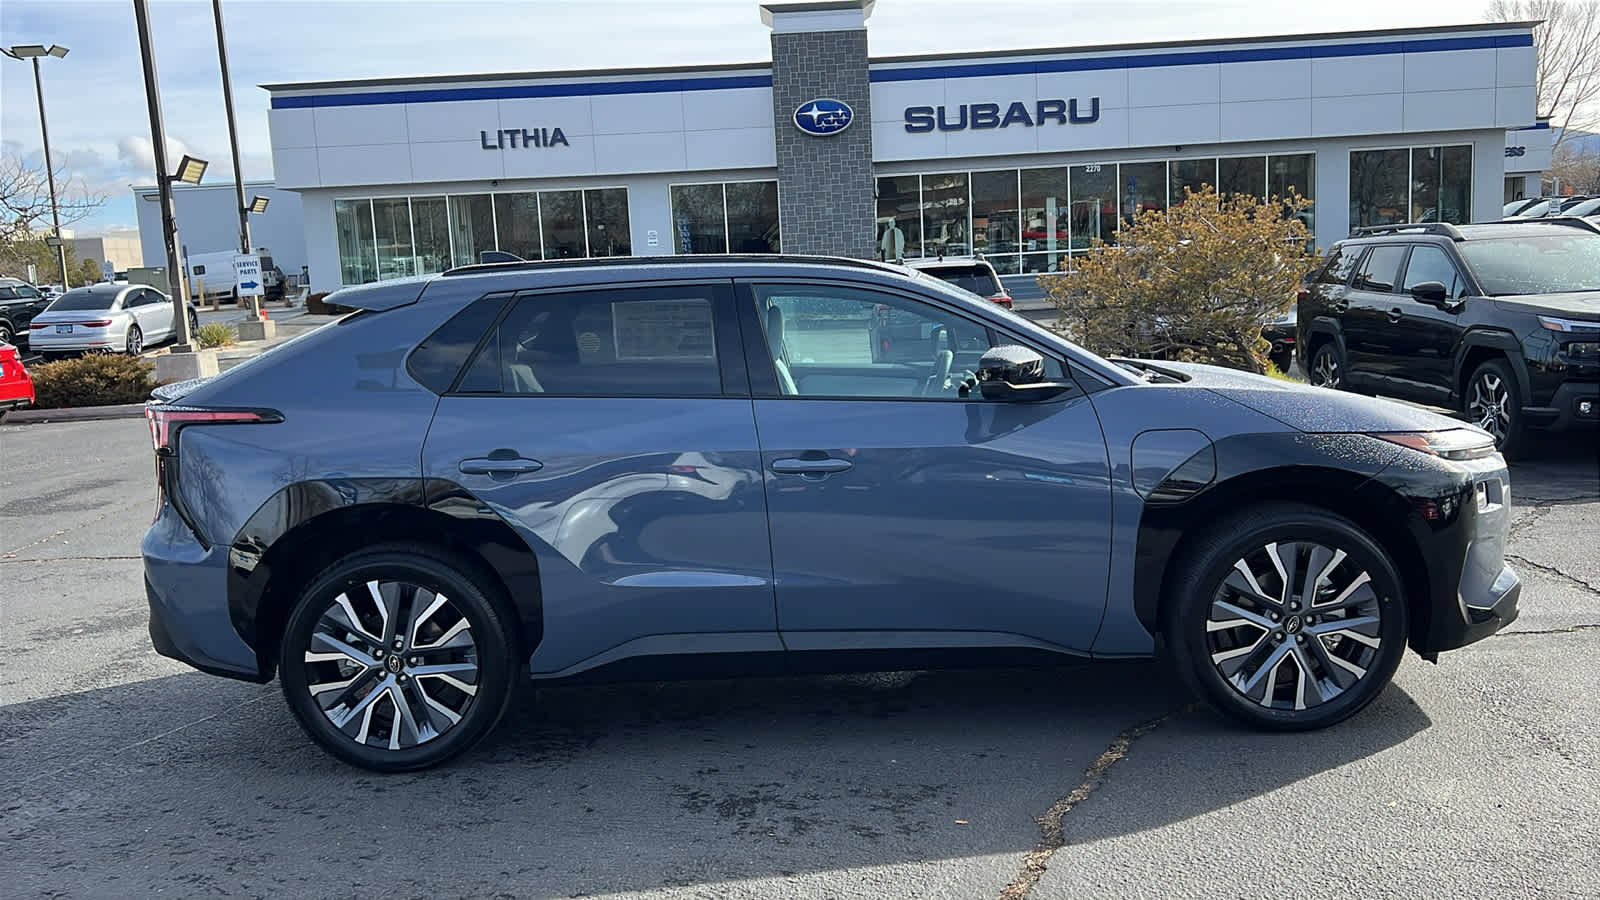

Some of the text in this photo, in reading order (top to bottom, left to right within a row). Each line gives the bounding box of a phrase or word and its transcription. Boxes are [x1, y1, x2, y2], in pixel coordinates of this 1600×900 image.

[904, 97, 1100, 133] SUBARU
[480, 127, 569, 150] LITHIA
[1085, 165, 1101, 173] 2270
[236, 260, 258, 268] SERVICE
